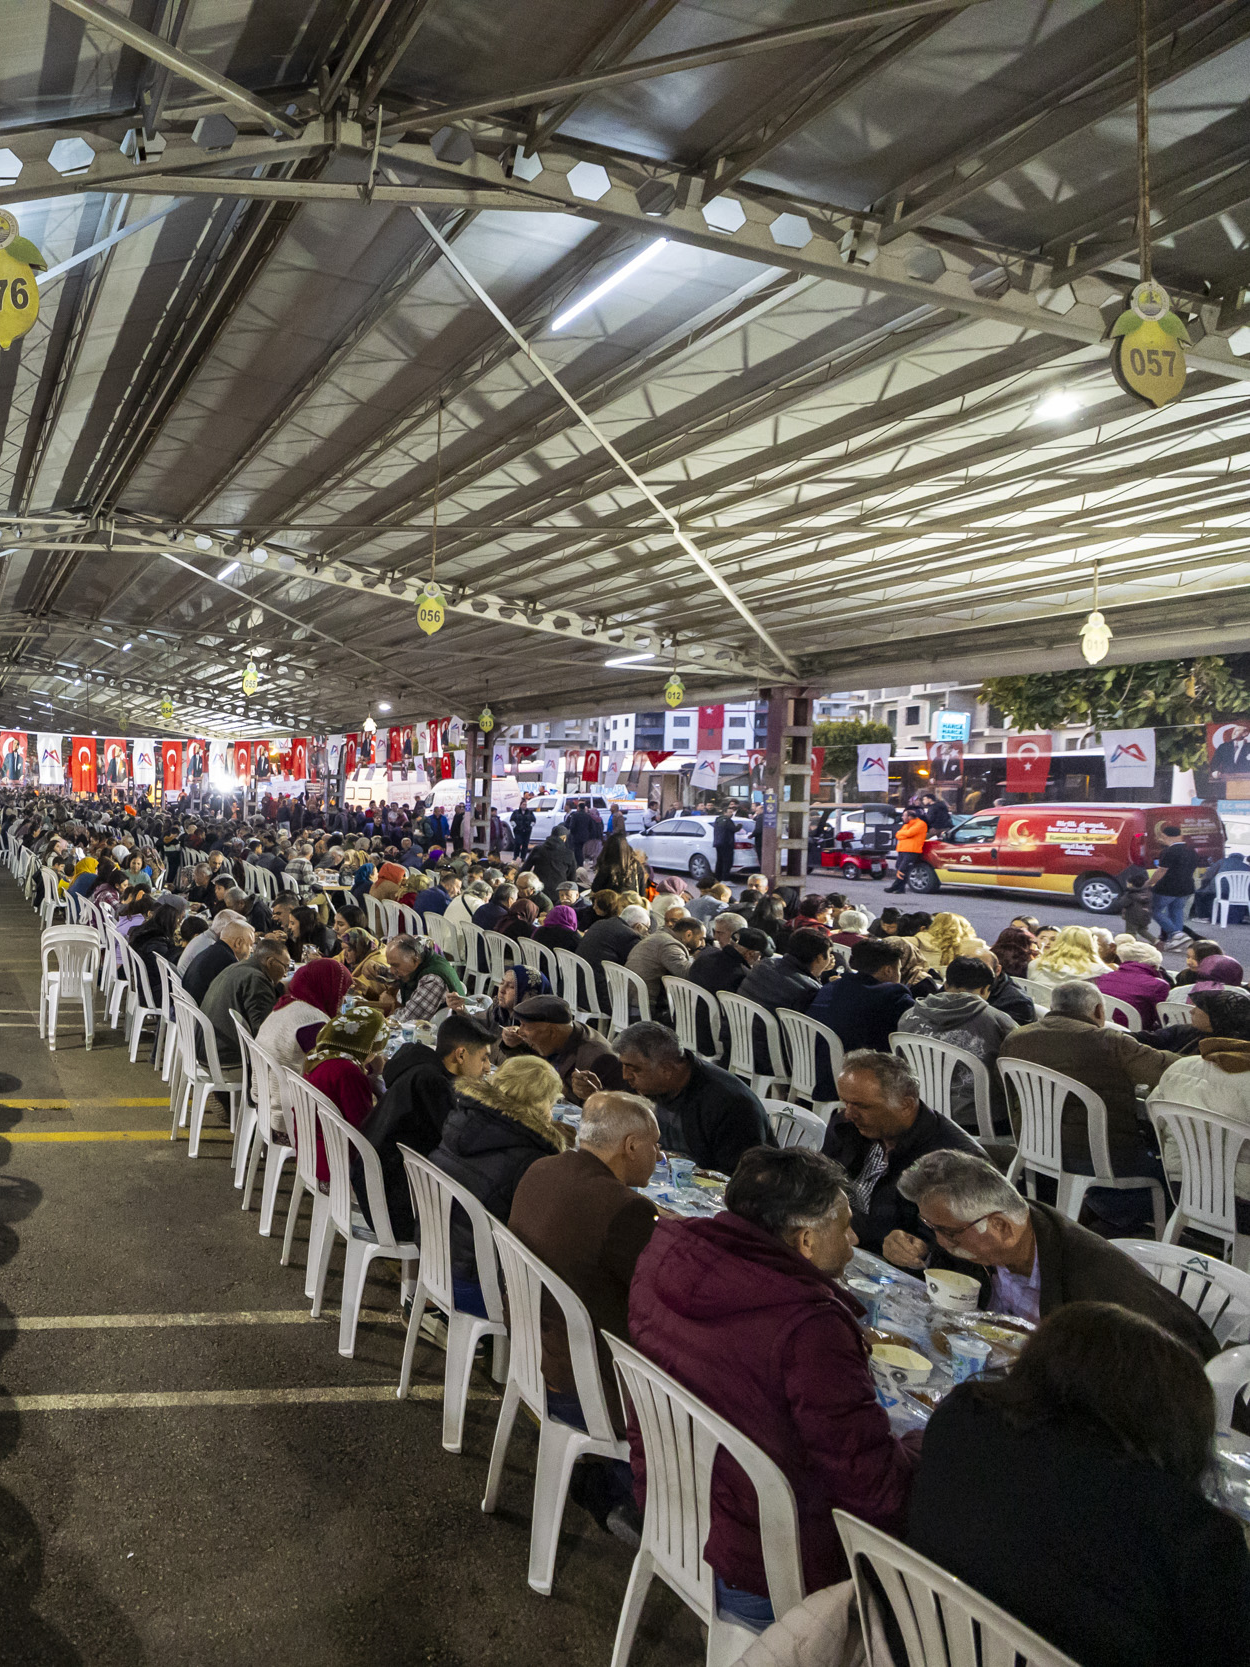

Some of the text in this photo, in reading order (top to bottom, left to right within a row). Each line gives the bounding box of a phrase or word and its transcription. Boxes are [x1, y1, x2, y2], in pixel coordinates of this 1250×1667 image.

[1129, 348, 1177, 378] 057
[420, 609, 441, 623] 056
[1086, 639, 1105, 651] 011
[667, 691, 682, 700] 012
